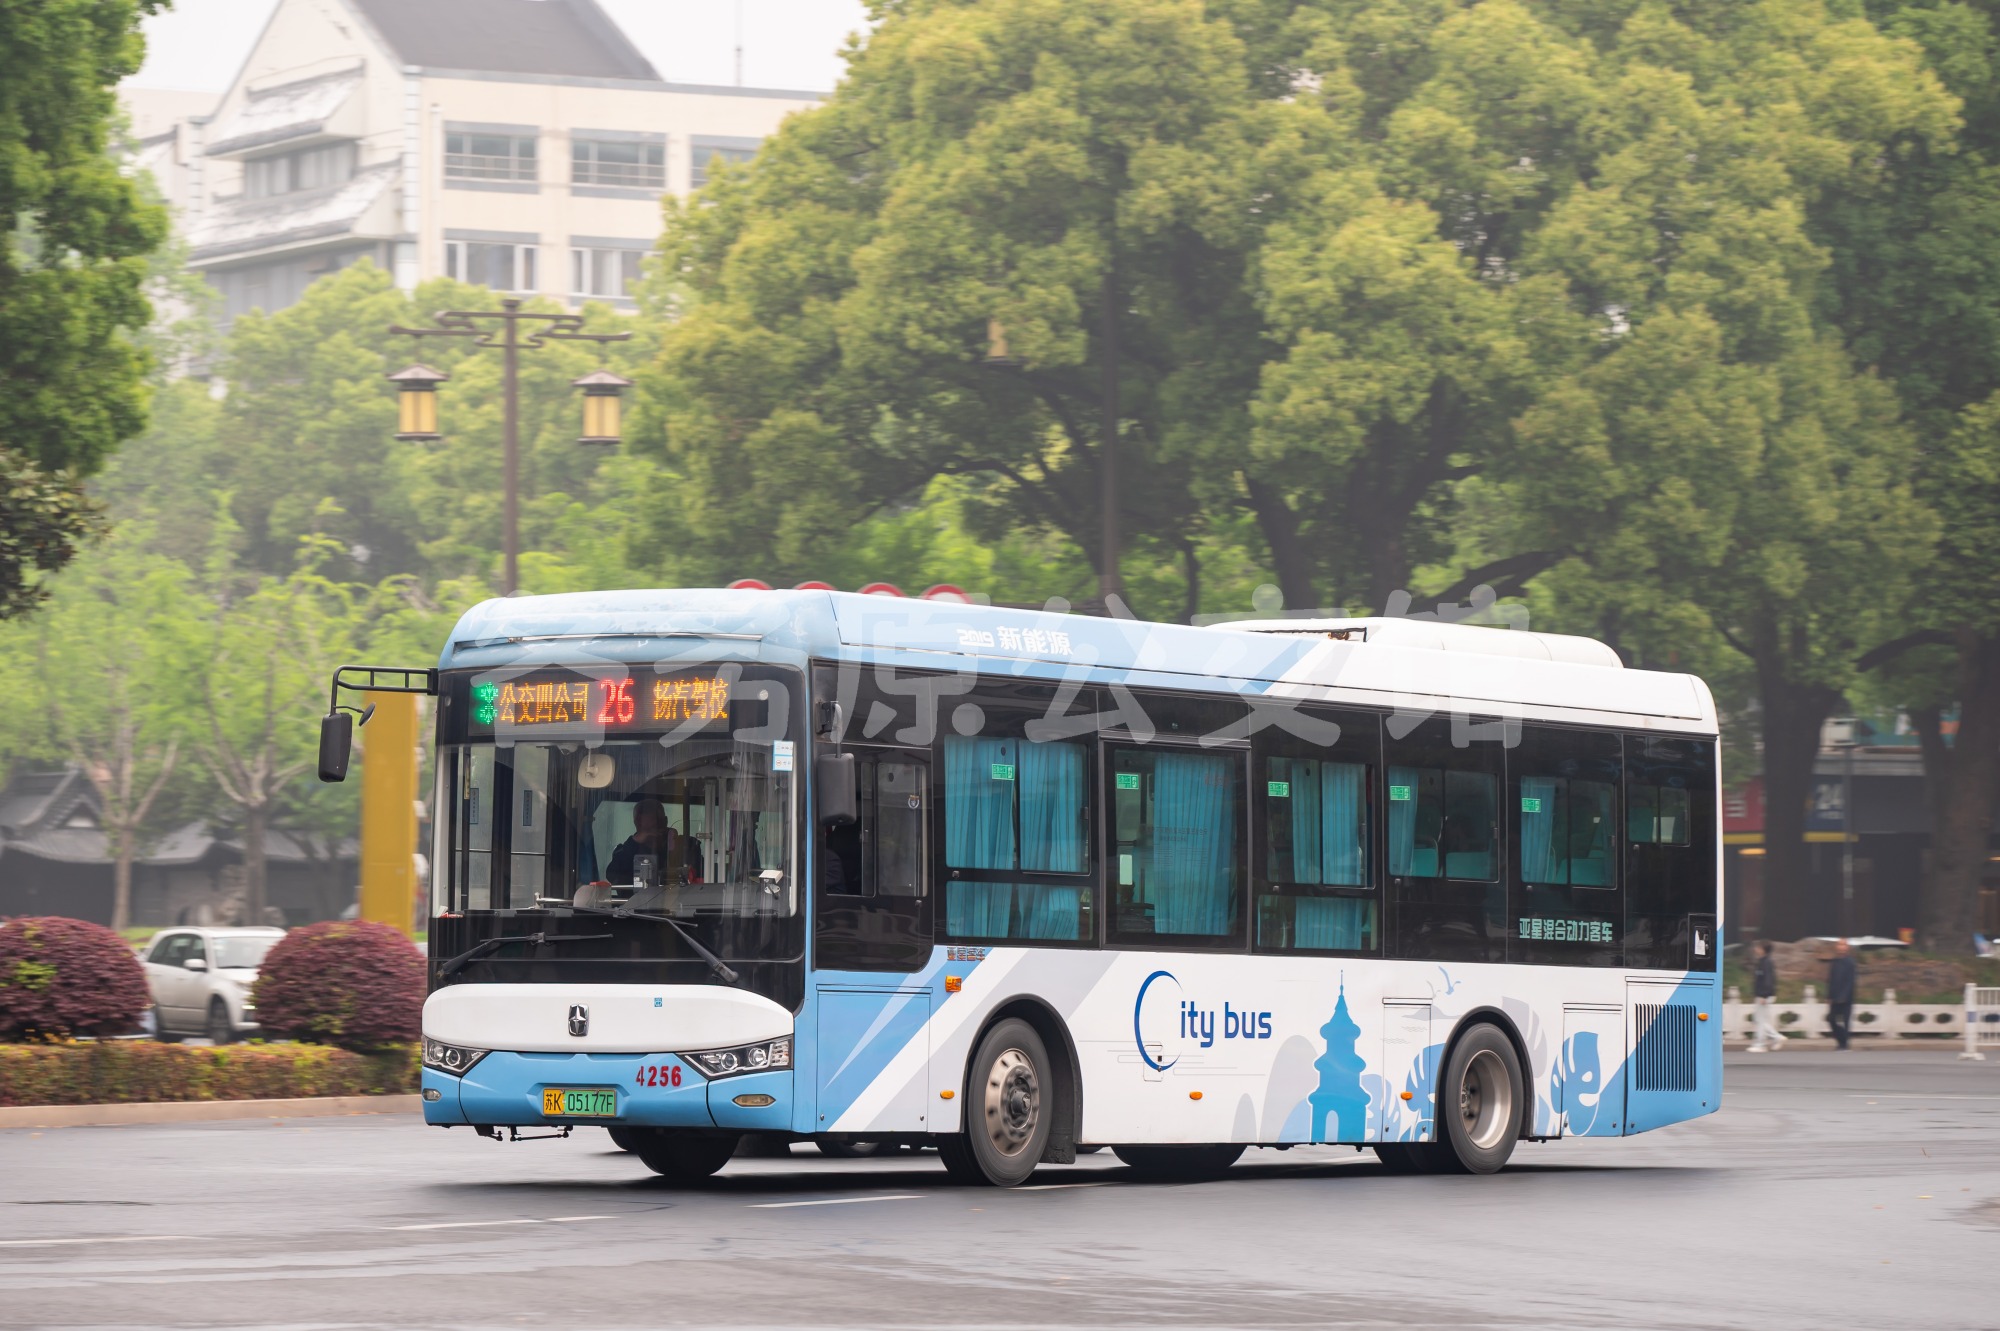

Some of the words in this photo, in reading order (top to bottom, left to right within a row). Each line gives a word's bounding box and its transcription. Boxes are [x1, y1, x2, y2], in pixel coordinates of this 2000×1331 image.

[996, 626, 1073, 655] 新能源
[499, 682, 589, 723] 公交四公司
[598, 678, 635, 724] 26
[653, 678, 729, 721] 扬汽驾校
[1519, 917, 1613, 943] 亚星混合动力客车
[1224, 1001, 1272, 1039] bus
[636, 1065, 682, 1087] 4256
